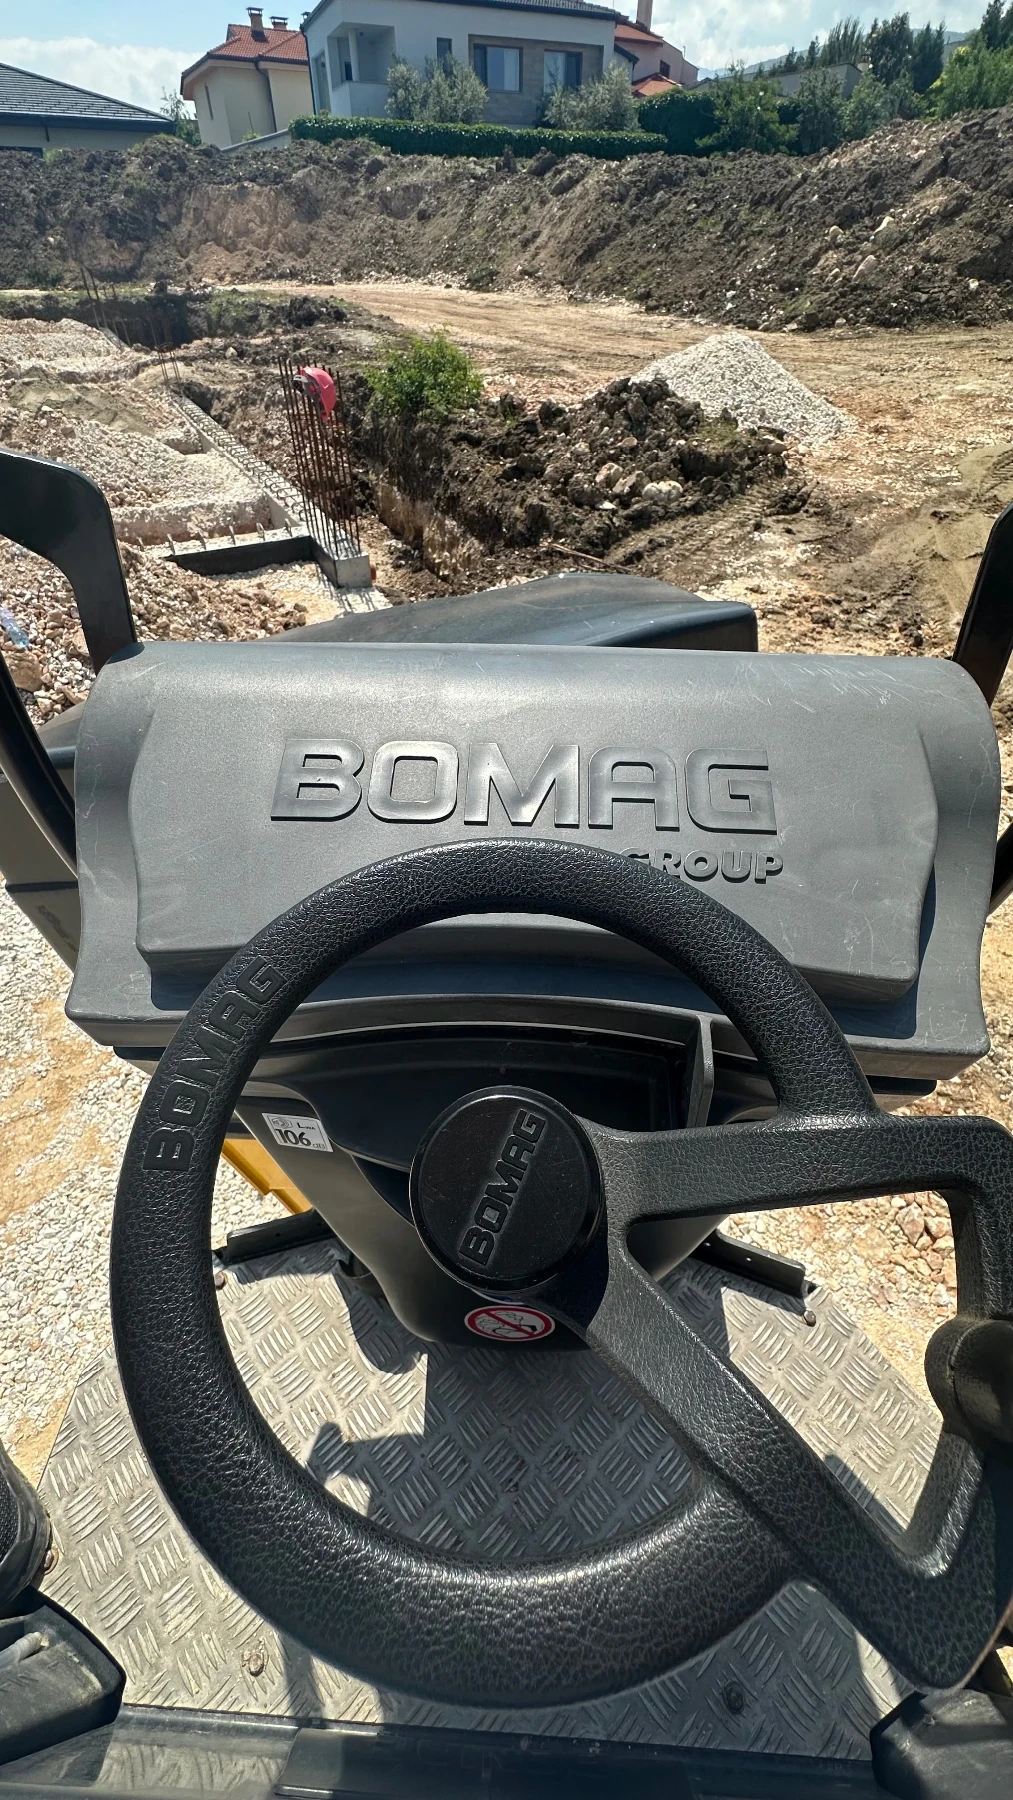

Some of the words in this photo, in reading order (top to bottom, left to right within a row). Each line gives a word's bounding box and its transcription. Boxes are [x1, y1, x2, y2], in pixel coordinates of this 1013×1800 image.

[270, 738, 778, 835] BOMAG
[142, 954, 288, 1172] BOMAG
[275, 1128, 311, 1147] 106
[457, 1108, 547, 1266] BOMAG
